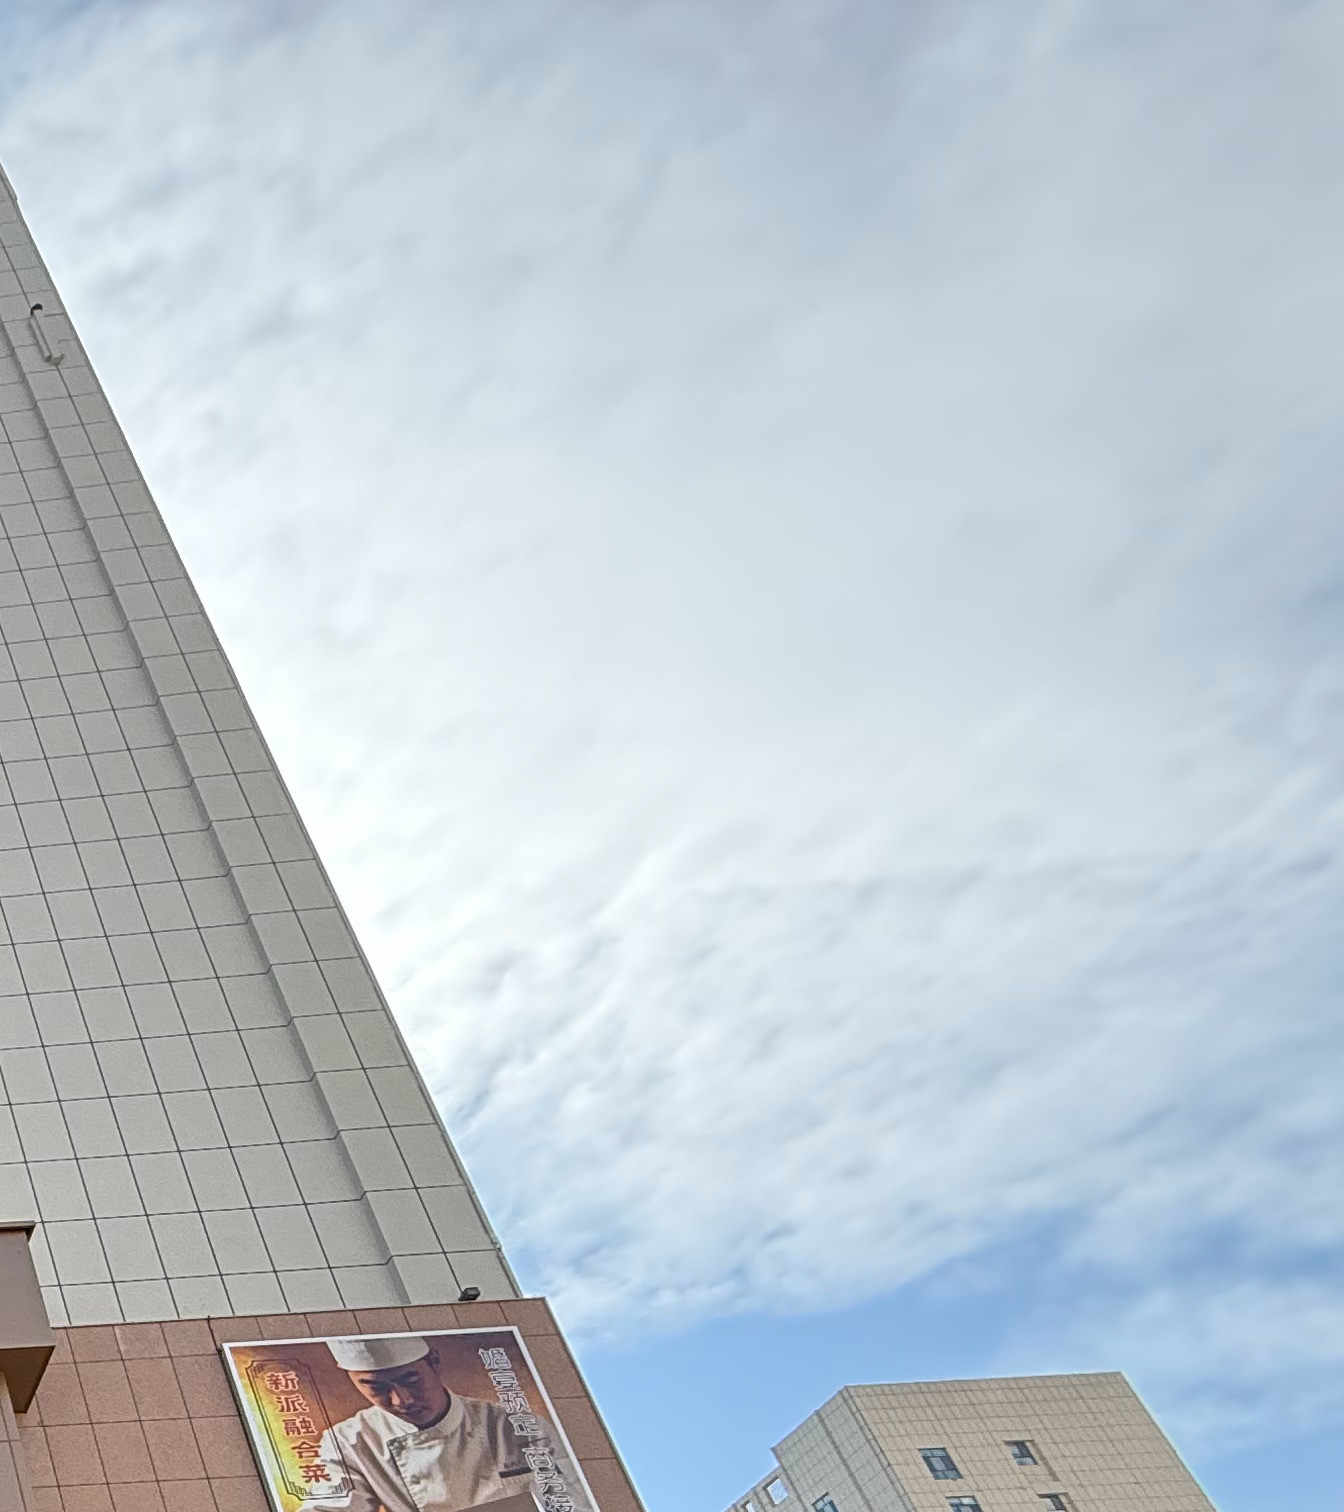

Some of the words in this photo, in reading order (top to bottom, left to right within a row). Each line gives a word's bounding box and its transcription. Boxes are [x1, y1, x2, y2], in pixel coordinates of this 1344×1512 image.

[265, 1370, 332, 1484] 新派融合菜
